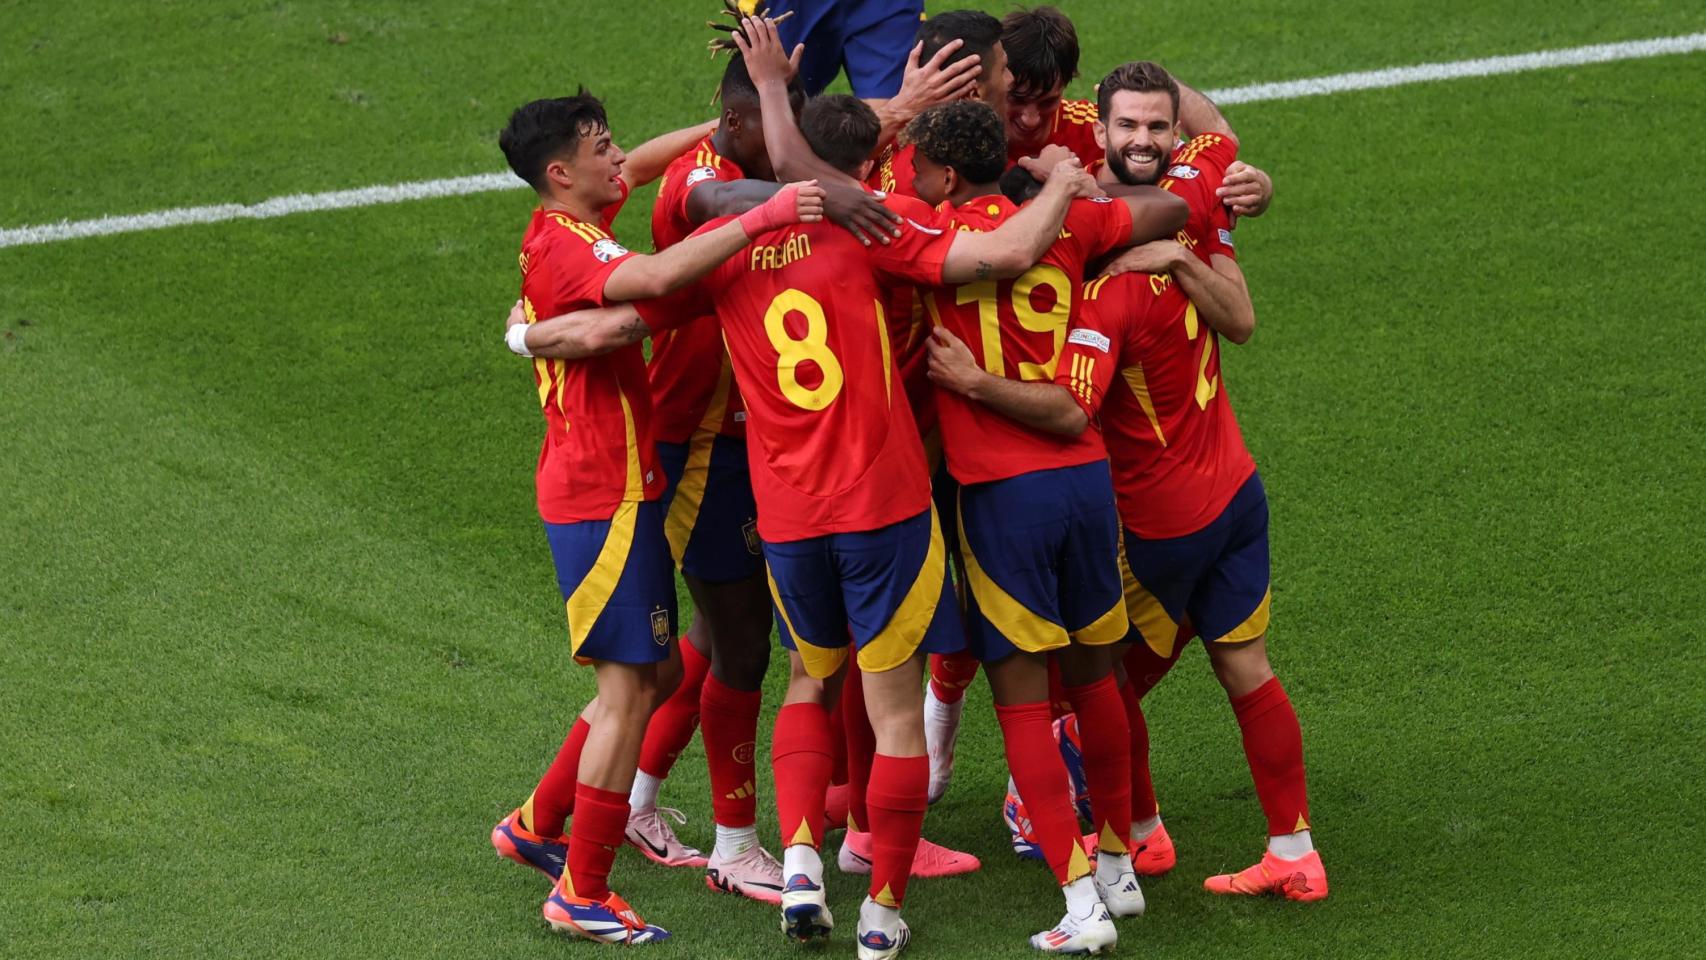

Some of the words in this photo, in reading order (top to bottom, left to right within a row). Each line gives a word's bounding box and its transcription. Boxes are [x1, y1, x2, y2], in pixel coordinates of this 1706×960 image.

[751, 232, 811, 271] FABIÁN
[764, 288, 844, 411] 8
[956, 264, 1071, 381] 19
